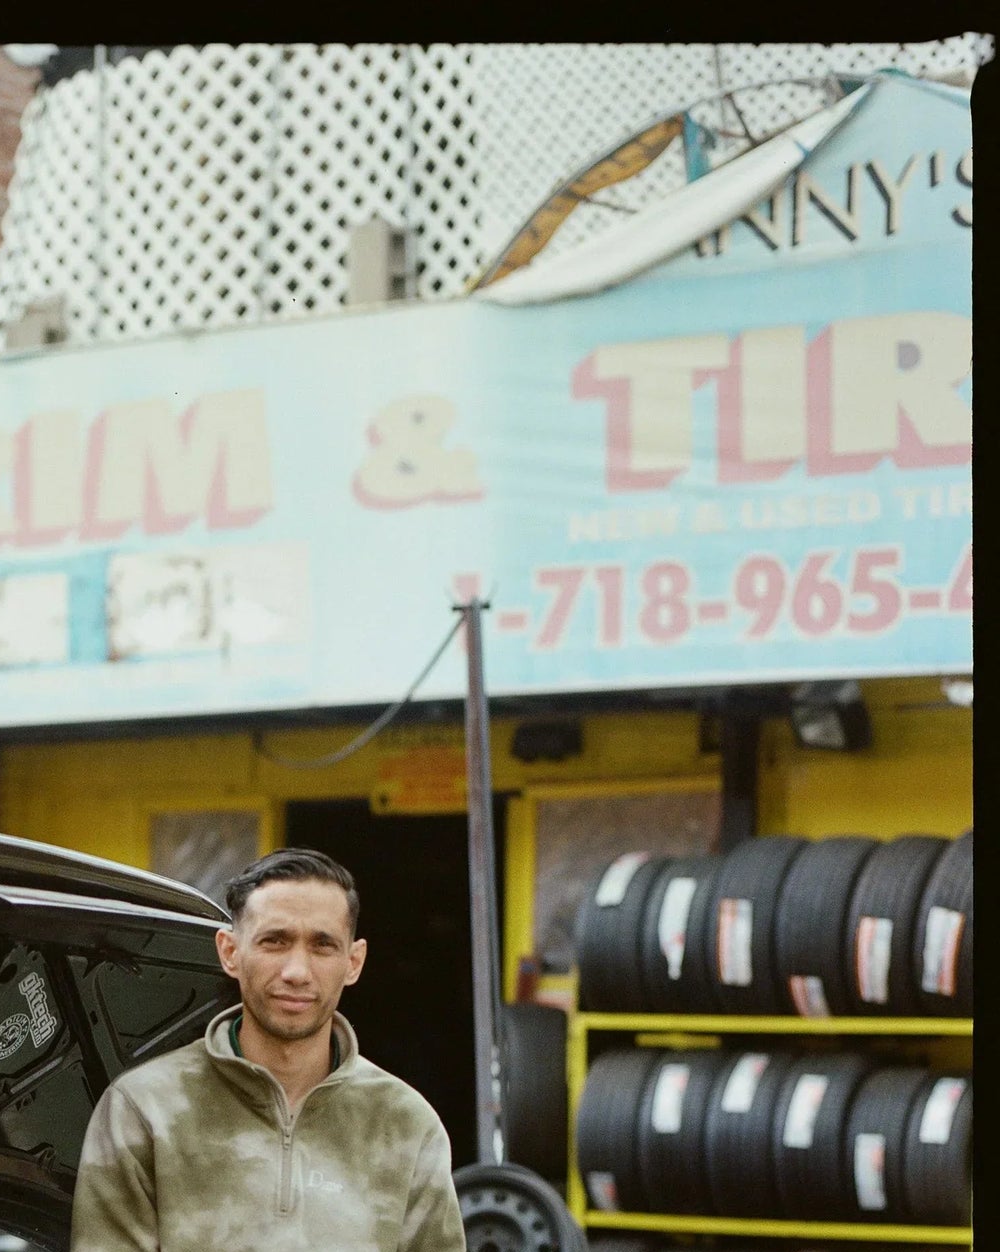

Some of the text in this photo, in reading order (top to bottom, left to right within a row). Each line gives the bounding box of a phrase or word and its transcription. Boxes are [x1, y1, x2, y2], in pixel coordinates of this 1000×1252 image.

[351, 393, 486, 511] &
[740, 488, 881, 529] USED
[19, 972, 57, 1042] gktech
